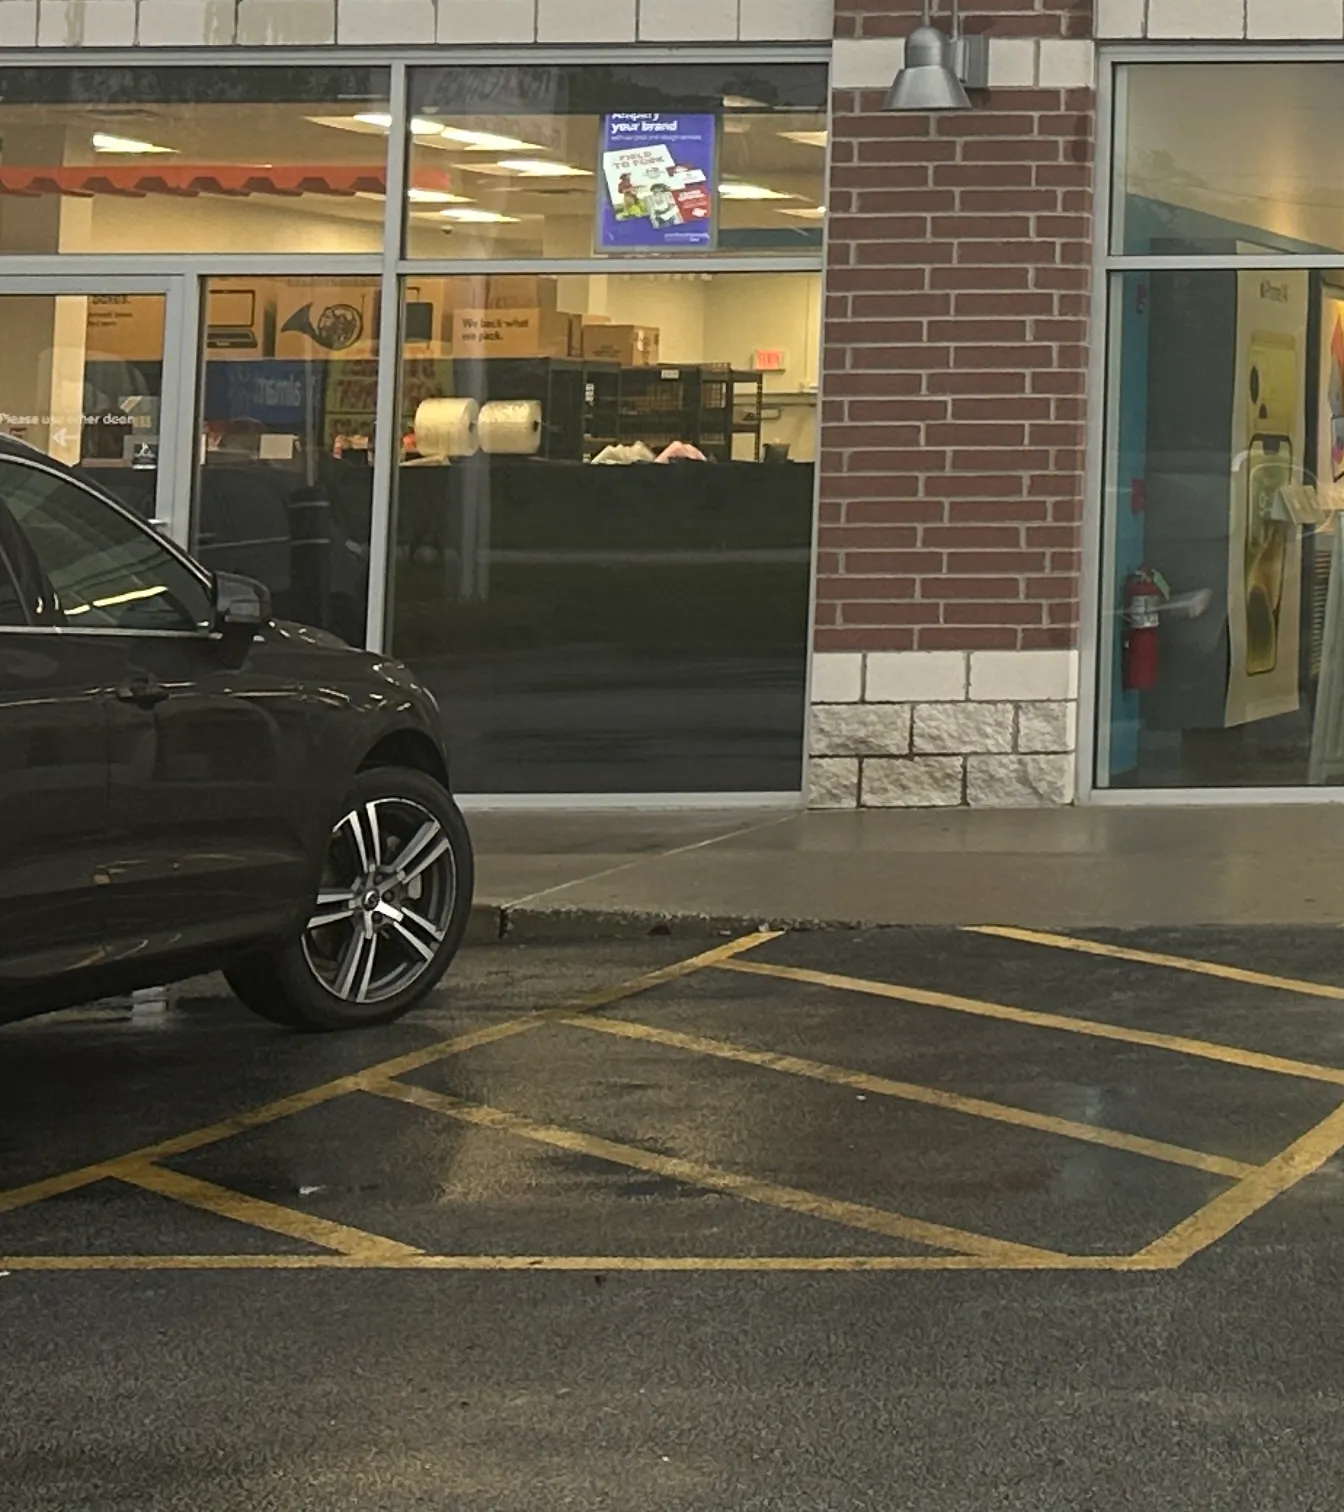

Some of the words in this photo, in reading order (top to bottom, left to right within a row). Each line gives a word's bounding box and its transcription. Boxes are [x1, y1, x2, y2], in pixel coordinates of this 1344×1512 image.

[611, 123, 640, 134] your
[641, 120, 678, 132] brand
[0, 412, 39, 425] Please
